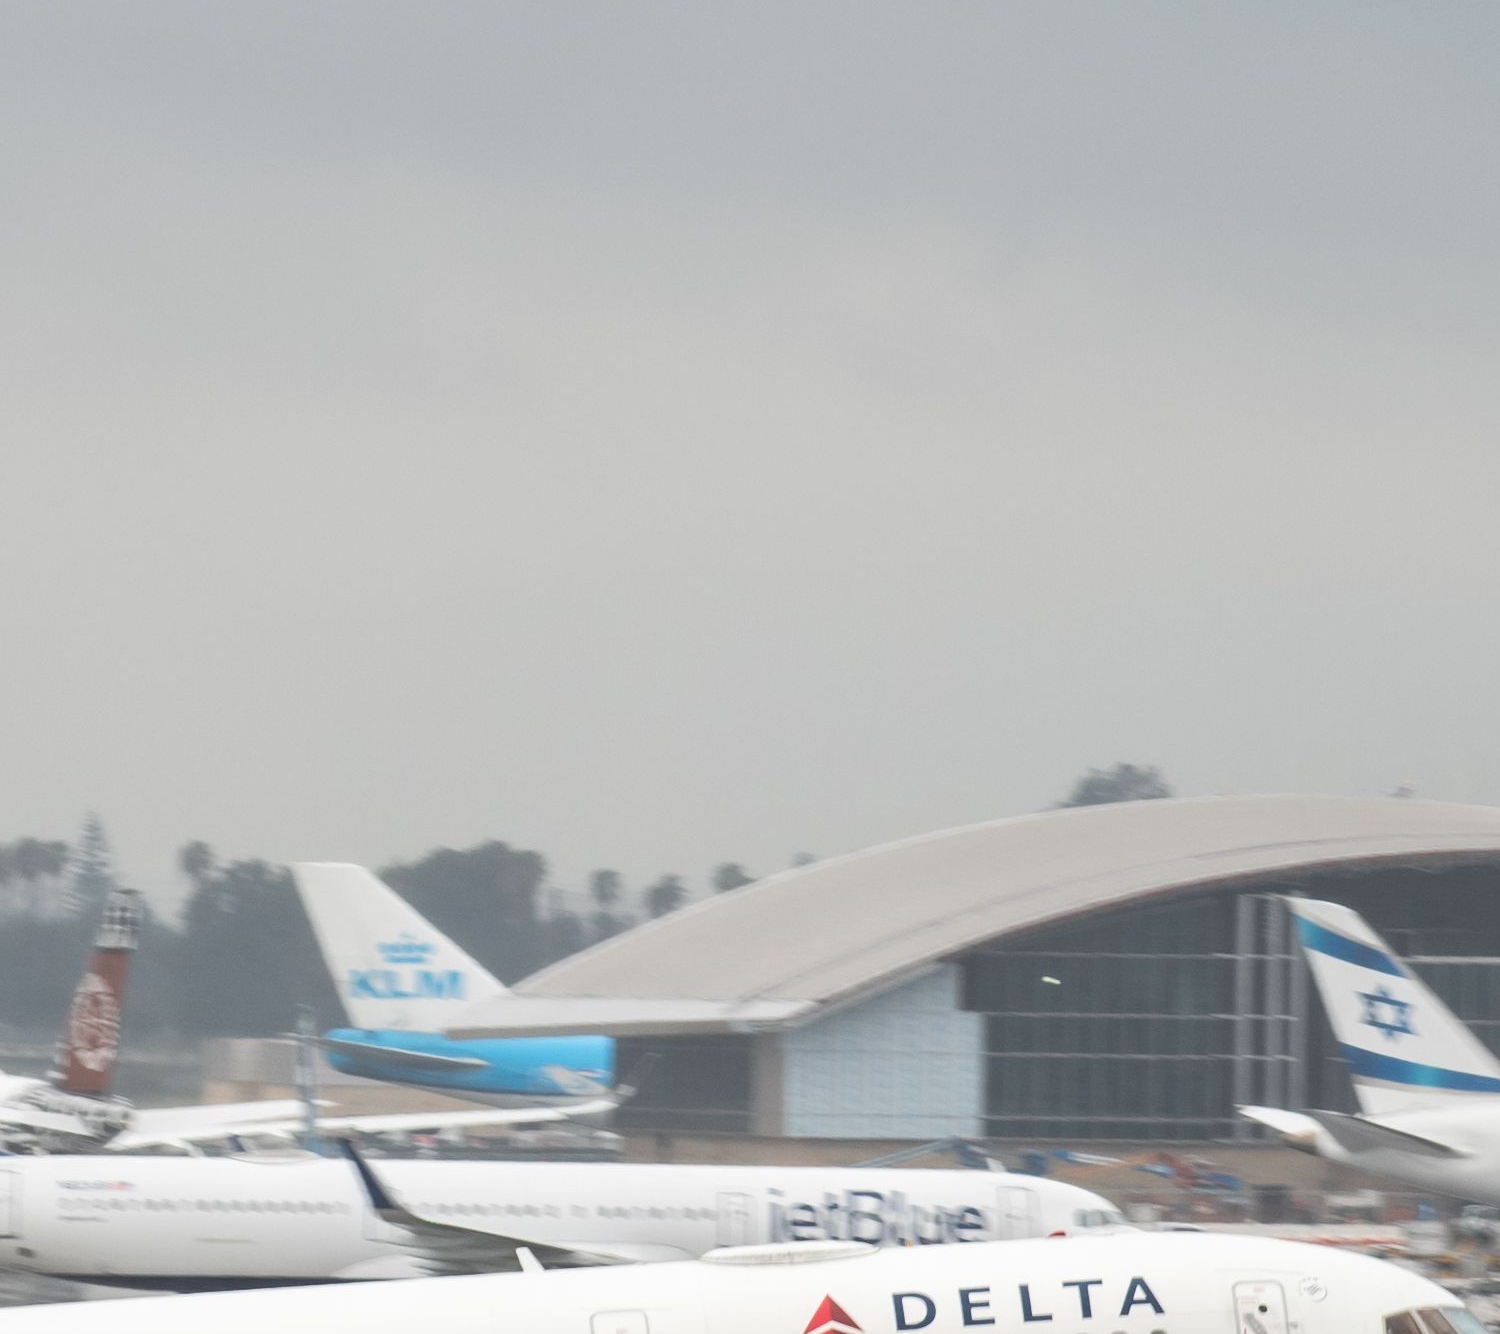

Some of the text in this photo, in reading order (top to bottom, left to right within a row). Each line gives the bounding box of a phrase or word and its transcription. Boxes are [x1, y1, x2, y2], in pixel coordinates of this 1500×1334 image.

[348, 970, 466, 1000] KLM
[766, 1187, 990, 1246] jetBlue
[892, 1276, 1165, 1331] DELTA
